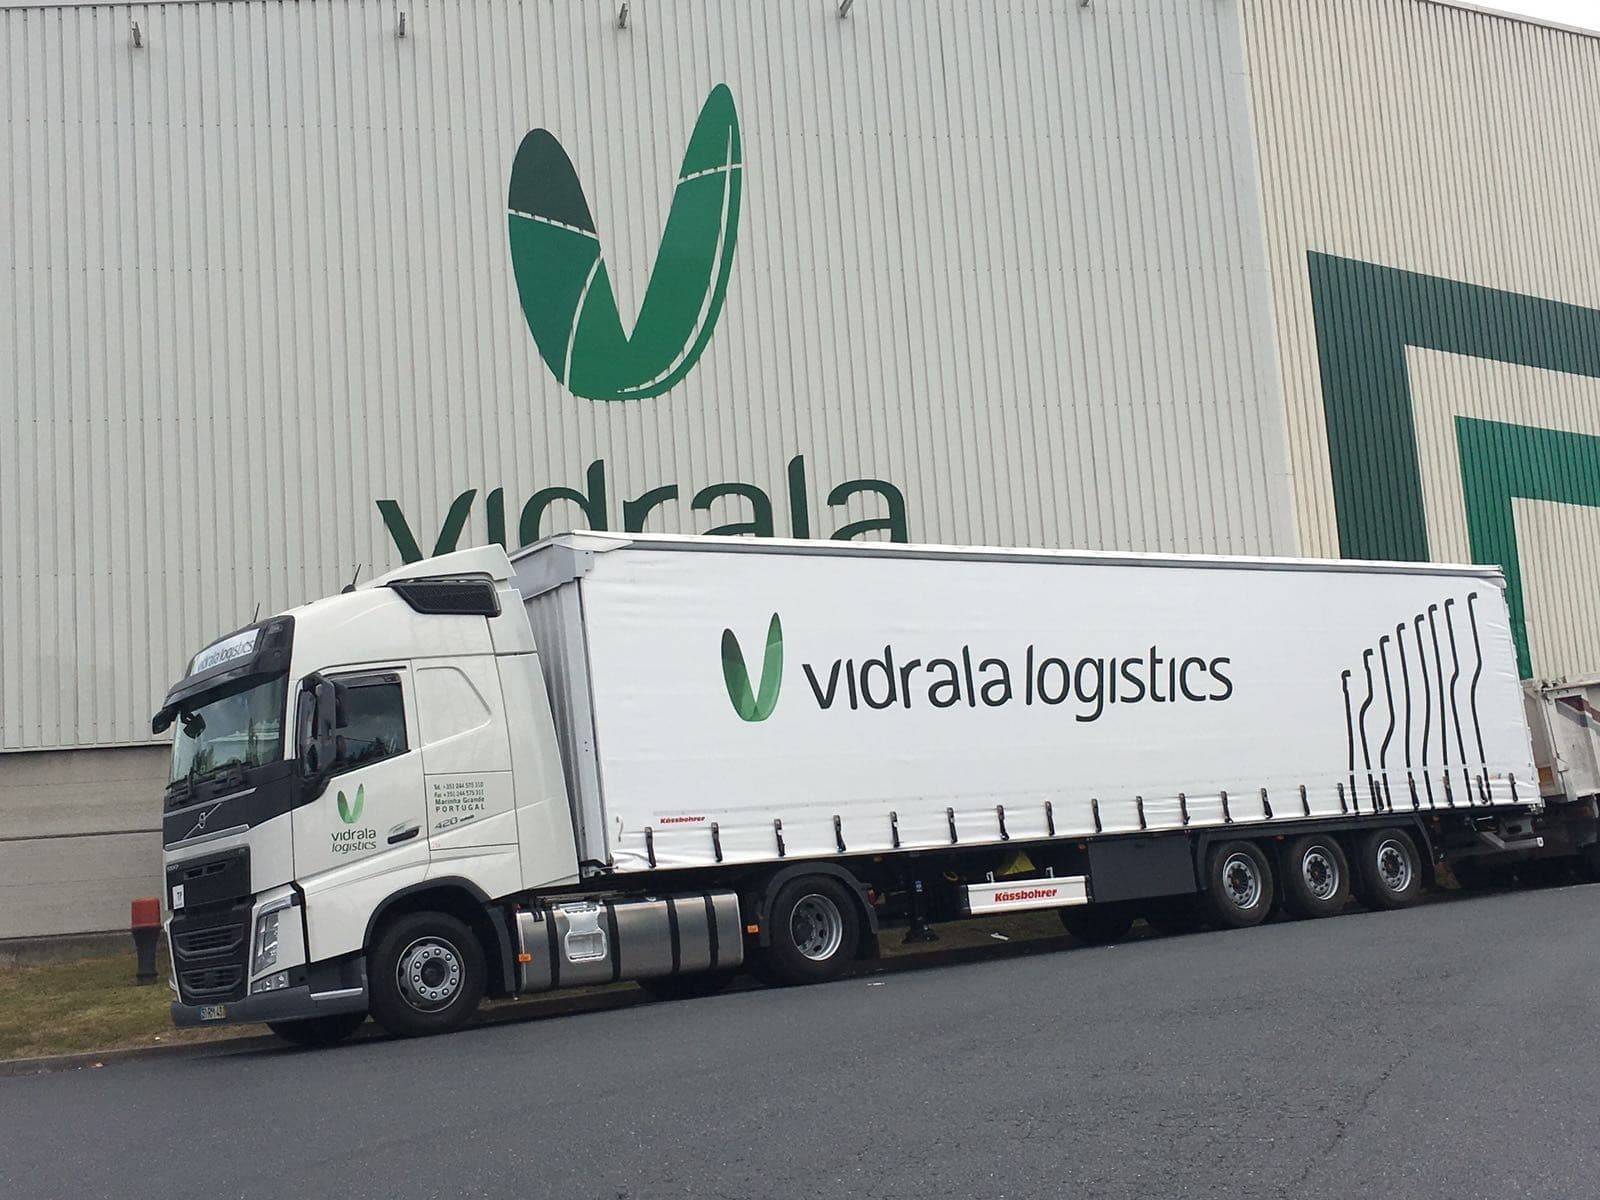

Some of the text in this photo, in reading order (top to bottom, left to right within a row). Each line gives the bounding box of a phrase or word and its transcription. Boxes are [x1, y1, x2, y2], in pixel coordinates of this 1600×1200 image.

[376, 455, 908, 563] vidrala
[802, 644, 1233, 722] vidrala logistics
[462, 796, 485, 804] Grande
[435, 803, 485, 812] PORTUGAL
[434, 816, 458, 829] 420
[331, 828, 377, 842] vidrala
[331, 841, 377, 855] logistics
[994, 888, 1058, 902] Kässbohrer
